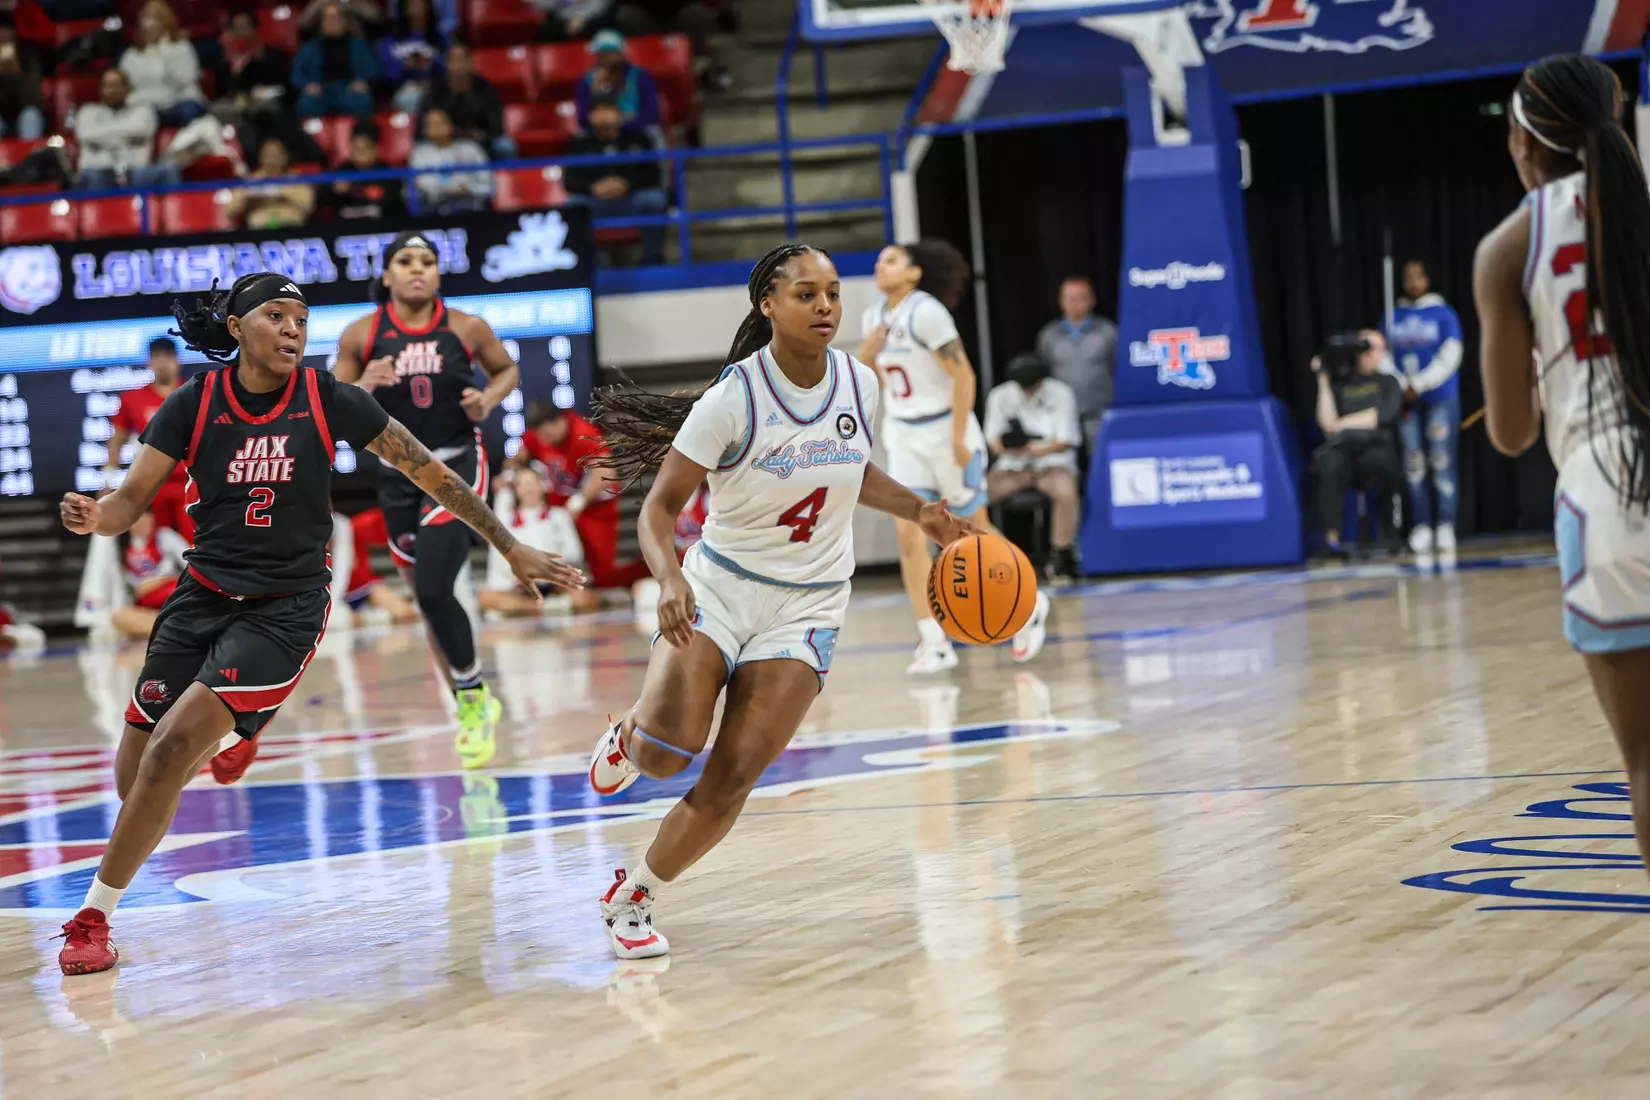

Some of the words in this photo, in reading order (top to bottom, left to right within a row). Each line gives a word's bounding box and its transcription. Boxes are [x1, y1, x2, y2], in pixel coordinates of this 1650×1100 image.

[72, 238, 338, 299] LOUISIANA
[335, 228, 470, 282] TH
[410, 375, 433, 409] 0
[235, 434, 291, 460] JAX
[751, 444, 797, 480] Lady
[796, 438, 864, 468] Techsters
[227, 457, 296, 484] STATE
[245, 487, 275, 527] 2
[776, 487, 829, 544] 4
